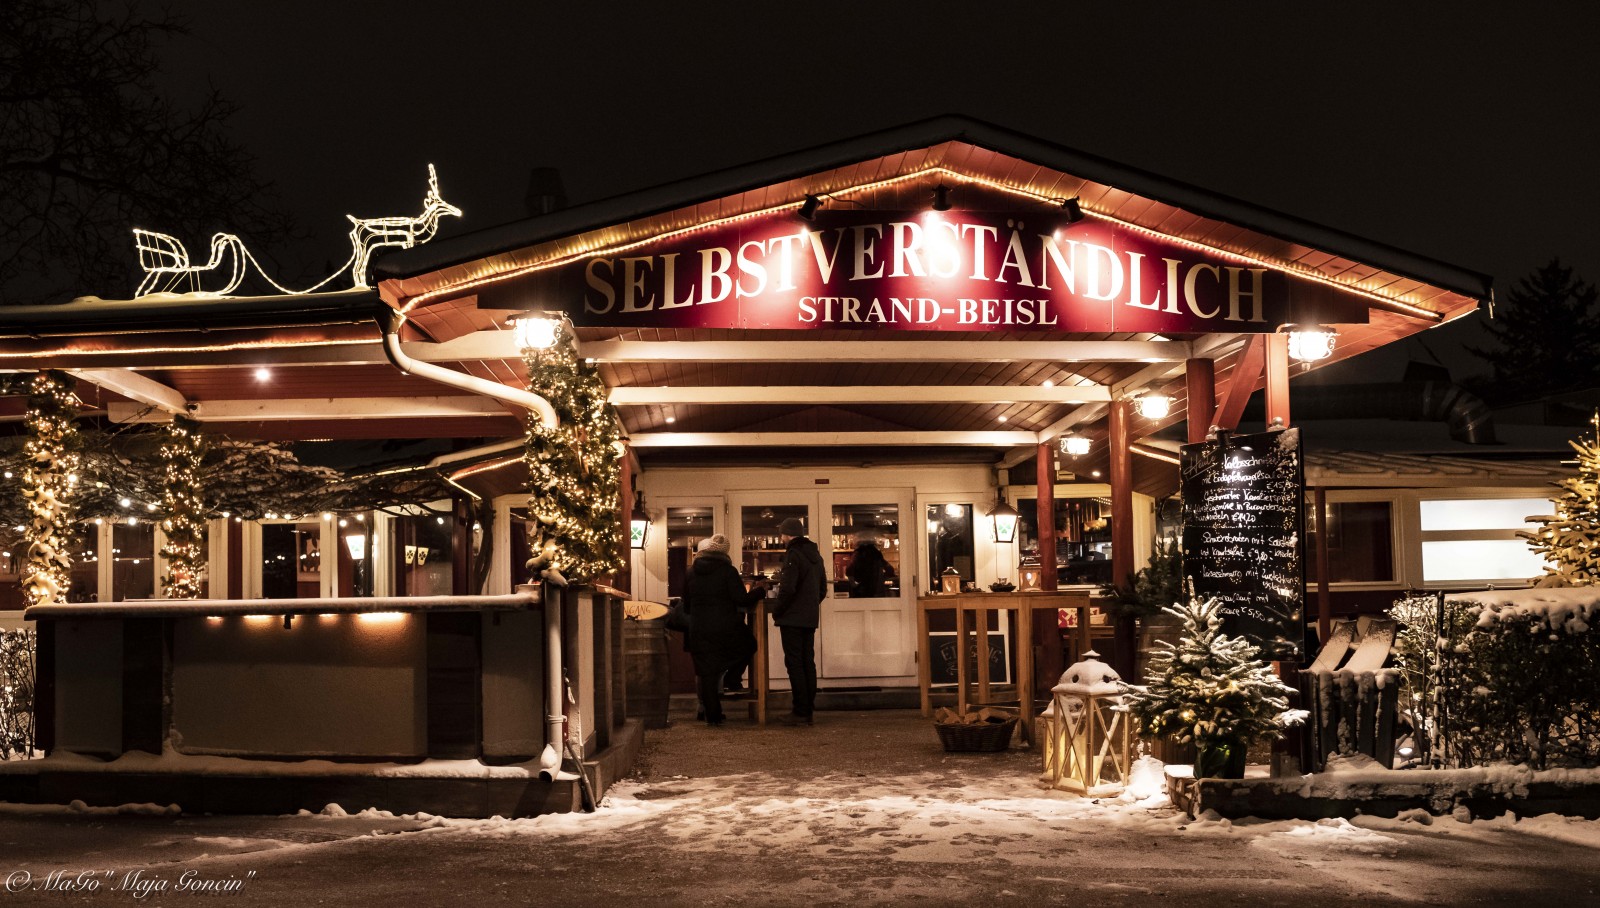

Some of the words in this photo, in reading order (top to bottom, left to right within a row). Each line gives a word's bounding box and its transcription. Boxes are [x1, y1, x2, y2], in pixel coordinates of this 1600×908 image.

[584, 219, 1267, 323] SELBSTVERSTÄNDLICH
[798, 296, 1058, 325] STRAND-BEISL
[1252, 533, 1265, 544] mit
[1246, 567, 1259, 580] mit
